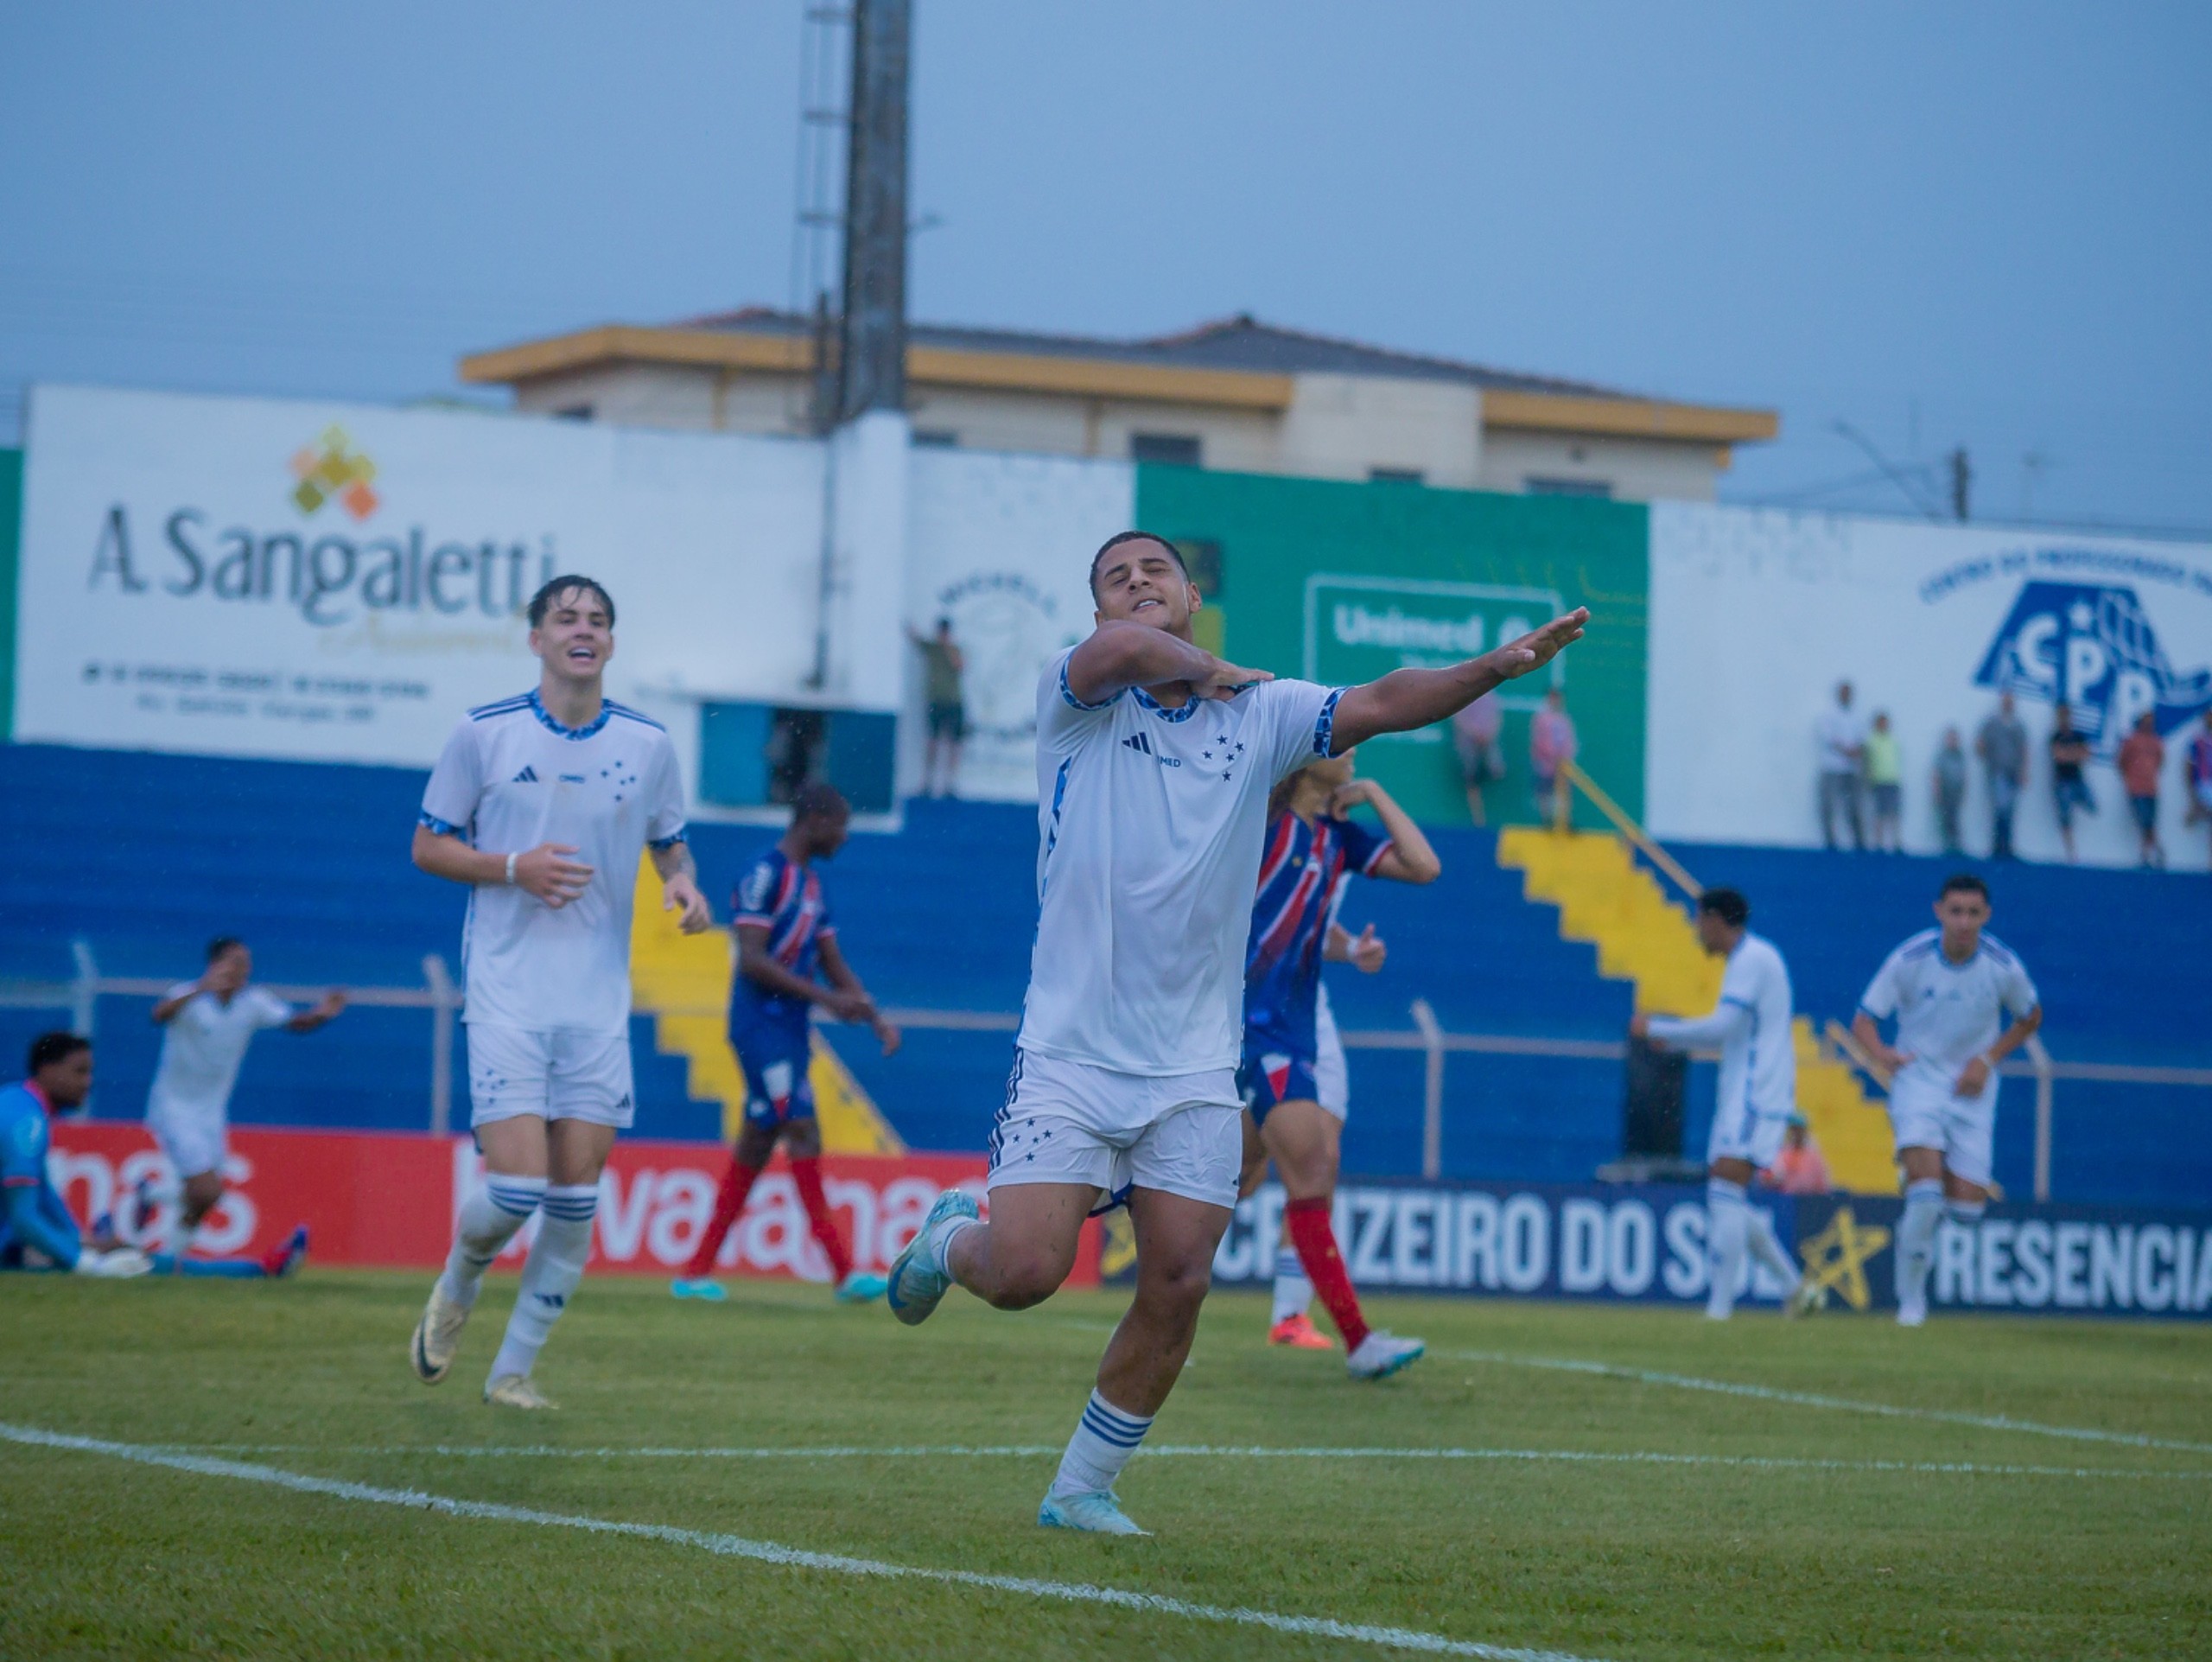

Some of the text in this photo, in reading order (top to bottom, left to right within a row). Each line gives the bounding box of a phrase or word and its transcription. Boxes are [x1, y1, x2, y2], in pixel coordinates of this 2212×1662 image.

[164, 506, 555, 627] Sangaletti
[1332, 602, 1484, 652] Unimed
[1560, 1197, 1656, 1296] DO
[1897, 1218, 2212, 1312] RESENCI
